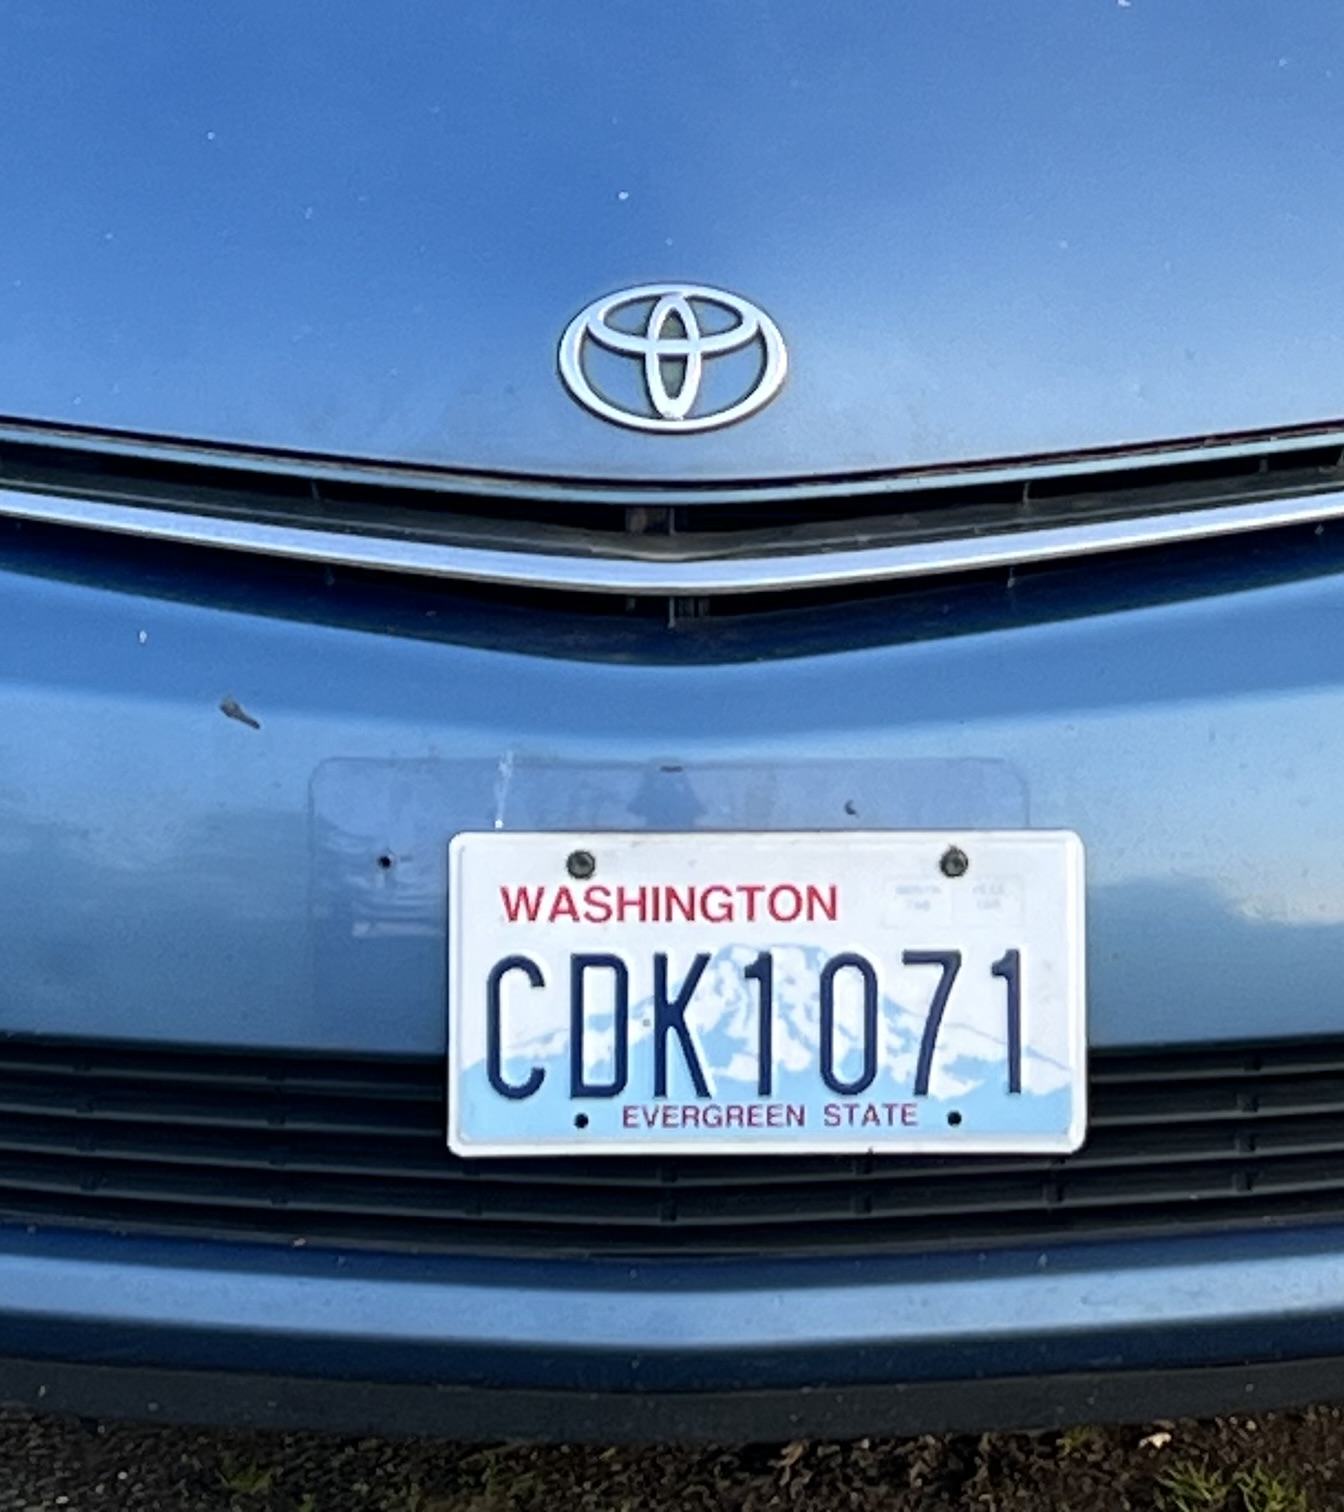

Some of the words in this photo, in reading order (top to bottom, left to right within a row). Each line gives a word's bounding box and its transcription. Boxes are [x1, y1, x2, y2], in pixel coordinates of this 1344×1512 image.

[501, 884, 838, 923] WASHINGTON
[487, 949, 1021, 1099] CDK1071
[623, 1104, 805, 1128] EVERGREEN
[824, 1103, 918, 1127] STATE
